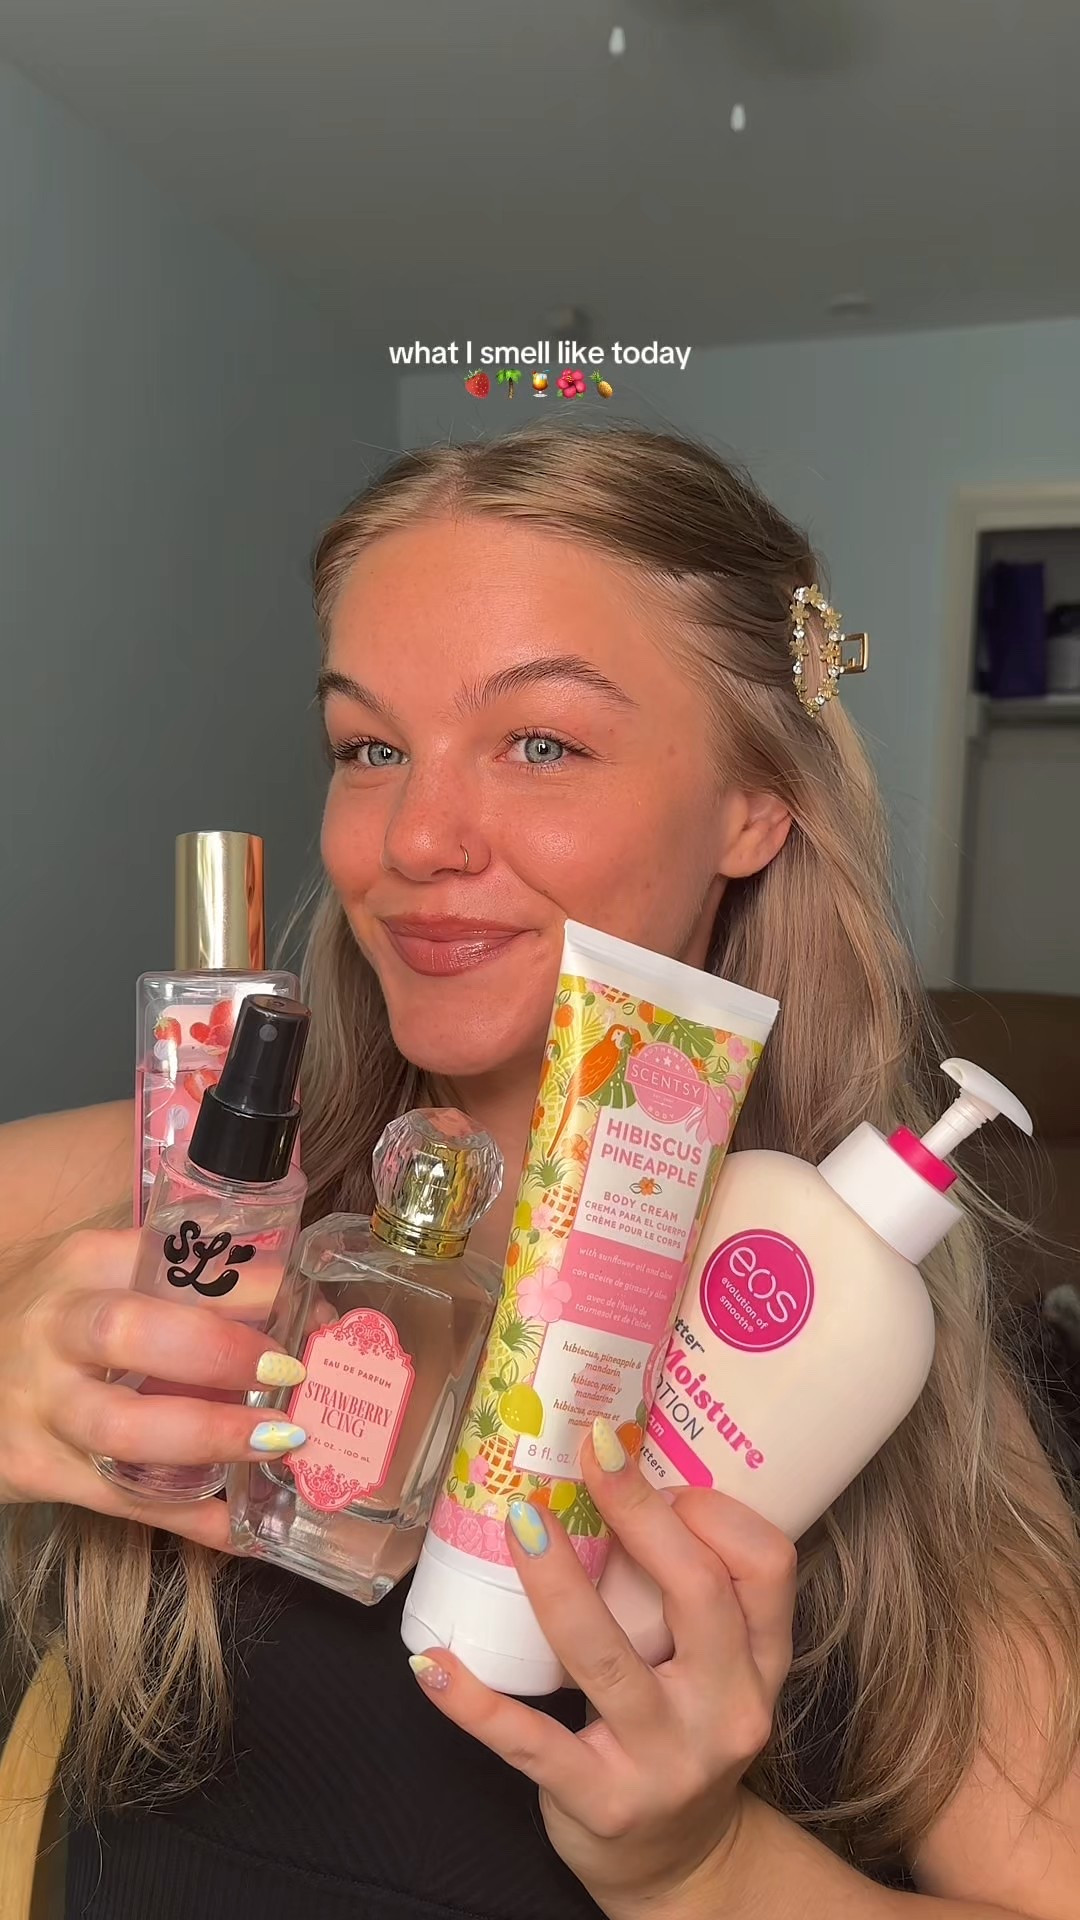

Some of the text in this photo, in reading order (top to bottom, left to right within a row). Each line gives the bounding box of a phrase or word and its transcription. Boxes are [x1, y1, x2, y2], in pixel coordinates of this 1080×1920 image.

[631, 1064, 701, 1098] SCENTSY
[606, 1118, 702, 1166] HIBISCUS
[601, 1144, 698, 1188] PINEAPPLE
[585, 1200, 687, 1238] CREMA PARA EL CUERPO
[603, 1191, 678, 1222] BODY CREAM
[619, 1223, 642, 1237] POUR
[644, 1231, 654, 1241] LE
[657, 1235, 681, 1249] CORPS
[580, 1248, 597, 1258] with
[729, 1247, 797, 1323] eos
[721, 1277, 769, 1330] evolution of
[562, 1340, 600, 1361] hibiscus,
[600, 1353, 635, 1369] pineapple
[585, 1362, 620, 1377] mandarin
[323, 1358, 392, 1389] EAU DE PARFUM
[304, 1380, 392, 1427] STRAWBERRY
[575, 1389, 613, 1404] mandarina
[657, 1374, 704, 1441] TION
[320, 1406, 366, 1438] ICING
[343, 1449, 359, 1458] 100
[528, 1444, 537, 1457] 8
[640, 1446, 667, 1478] tters
